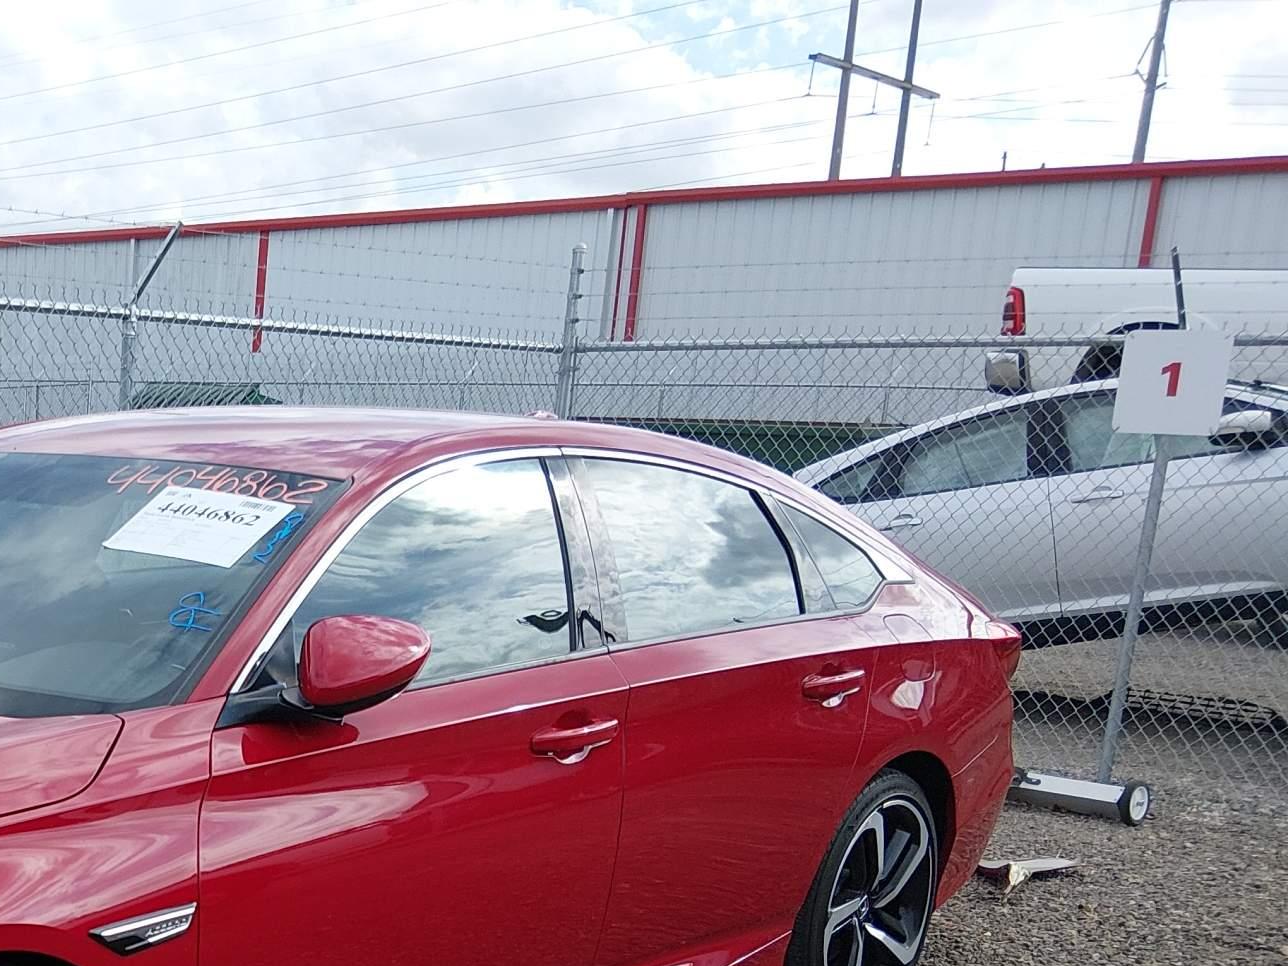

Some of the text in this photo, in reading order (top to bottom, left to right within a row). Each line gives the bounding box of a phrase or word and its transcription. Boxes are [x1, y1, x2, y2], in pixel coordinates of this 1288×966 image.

[1161, 361, 1182, 397] 1
[107, 464, 329, 504] 44046862
[157, 501, 261, 526] 44046862
